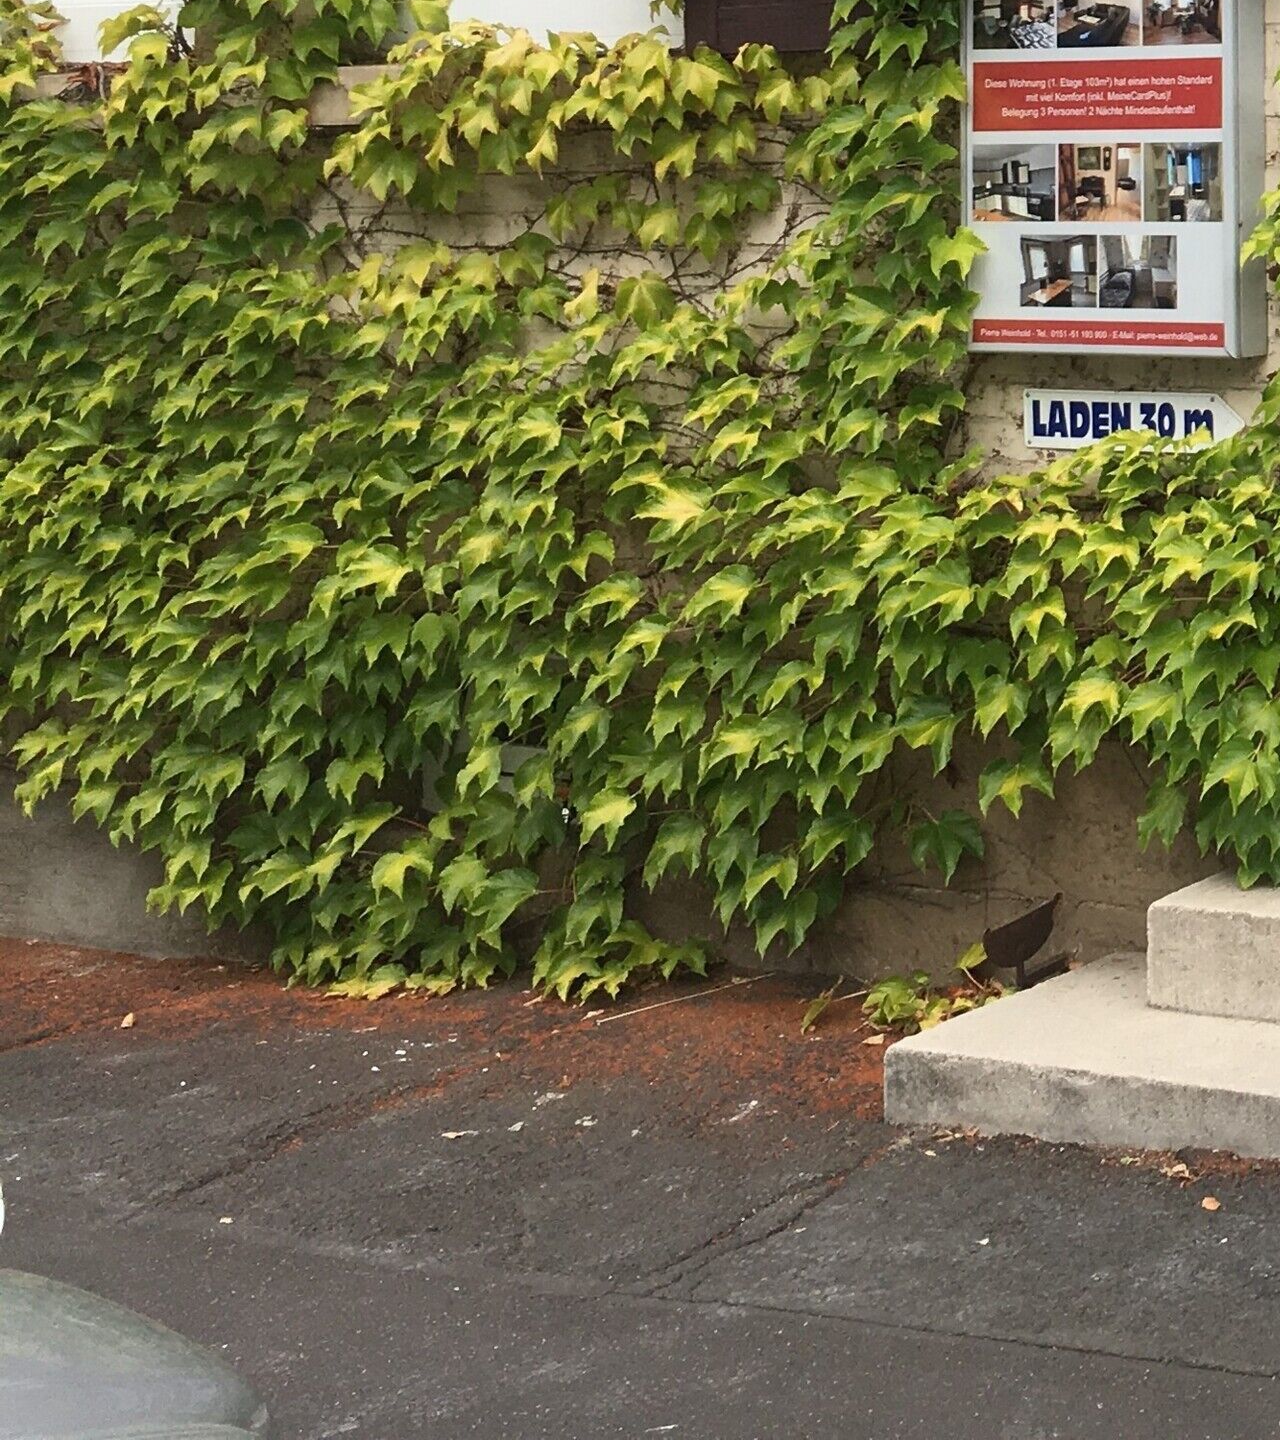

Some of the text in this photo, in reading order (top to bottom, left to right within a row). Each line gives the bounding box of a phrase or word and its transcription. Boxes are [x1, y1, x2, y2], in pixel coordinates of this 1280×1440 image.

[984, 78, 1008, 89] Diese
[1008, 78, 1046, 90] Wohnung
[1060, 77, 1083, 89] Etage
[1113, 76, 1127, 86] hat
[1127, 77, 1150, 86] einen
[1150, 76, 1176, 86] hohen
[1177, 75, 1213, 85] Standard
[1025, 93, 1039, 102] mit
[1039, 92, 1054, 102] viel
[1054, 92, 1086, 102] Komfort
[1001, 107, 1039, 118] Belegung
[1040, 107, 1046, 116] 3
[1088, 107, 1094, 116] 2
[1032, 399, 1214, 441] LADEN 30 m
